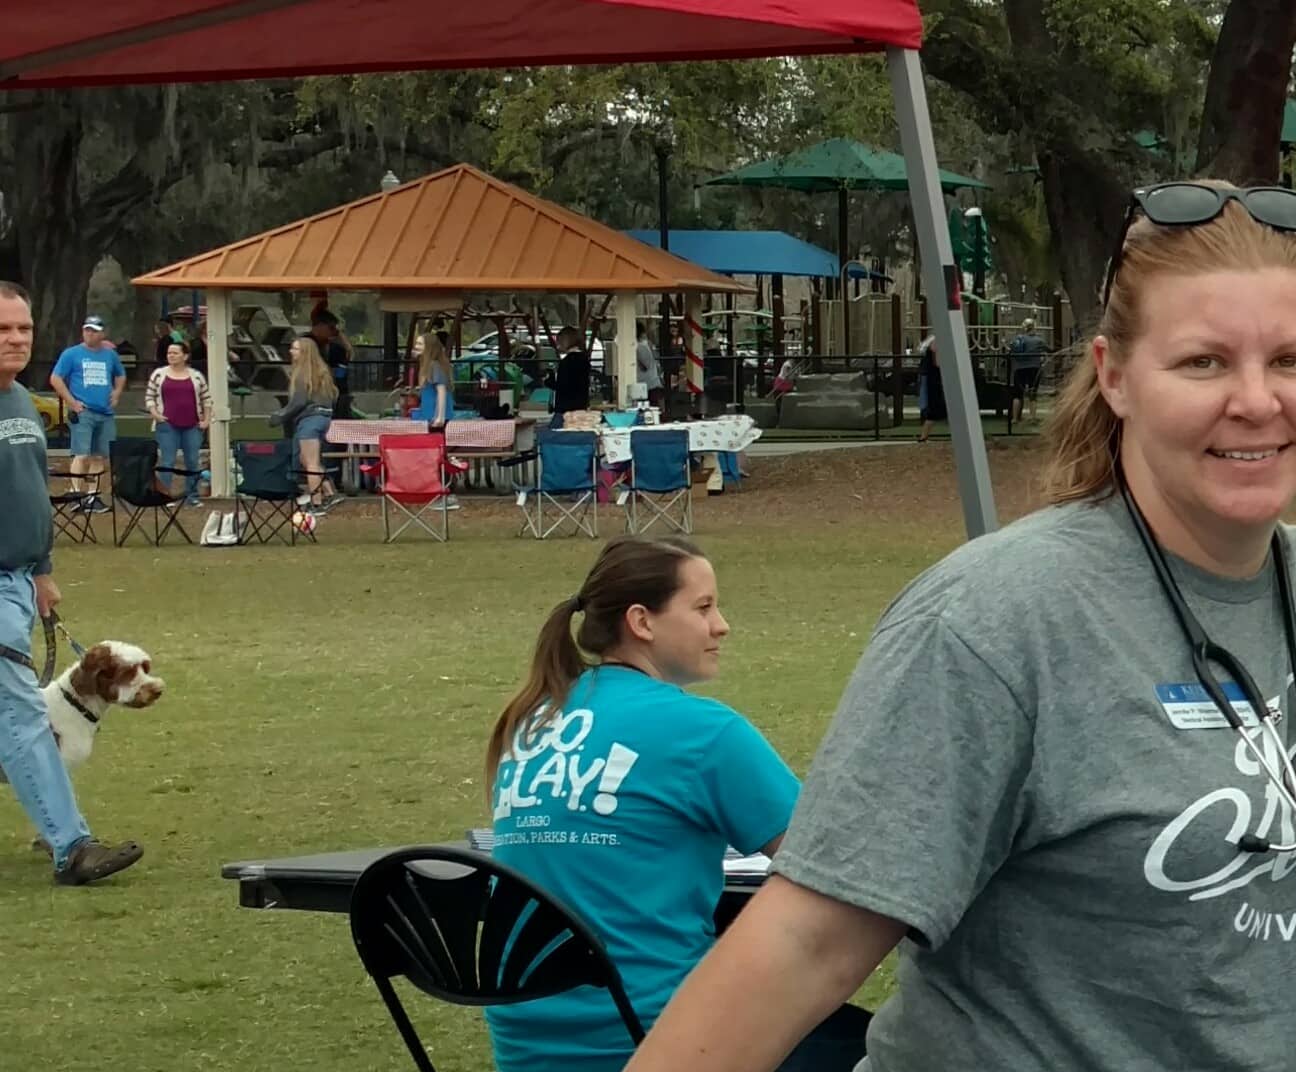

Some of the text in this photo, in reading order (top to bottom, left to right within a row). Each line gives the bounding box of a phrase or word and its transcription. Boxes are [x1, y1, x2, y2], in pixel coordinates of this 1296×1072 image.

[515, 815, 551, 828] LARGO
[531, 831, 567, 843] PARKS
[569, 831, 578, 843] &
[582, 833, 621, 845] ARTS.
